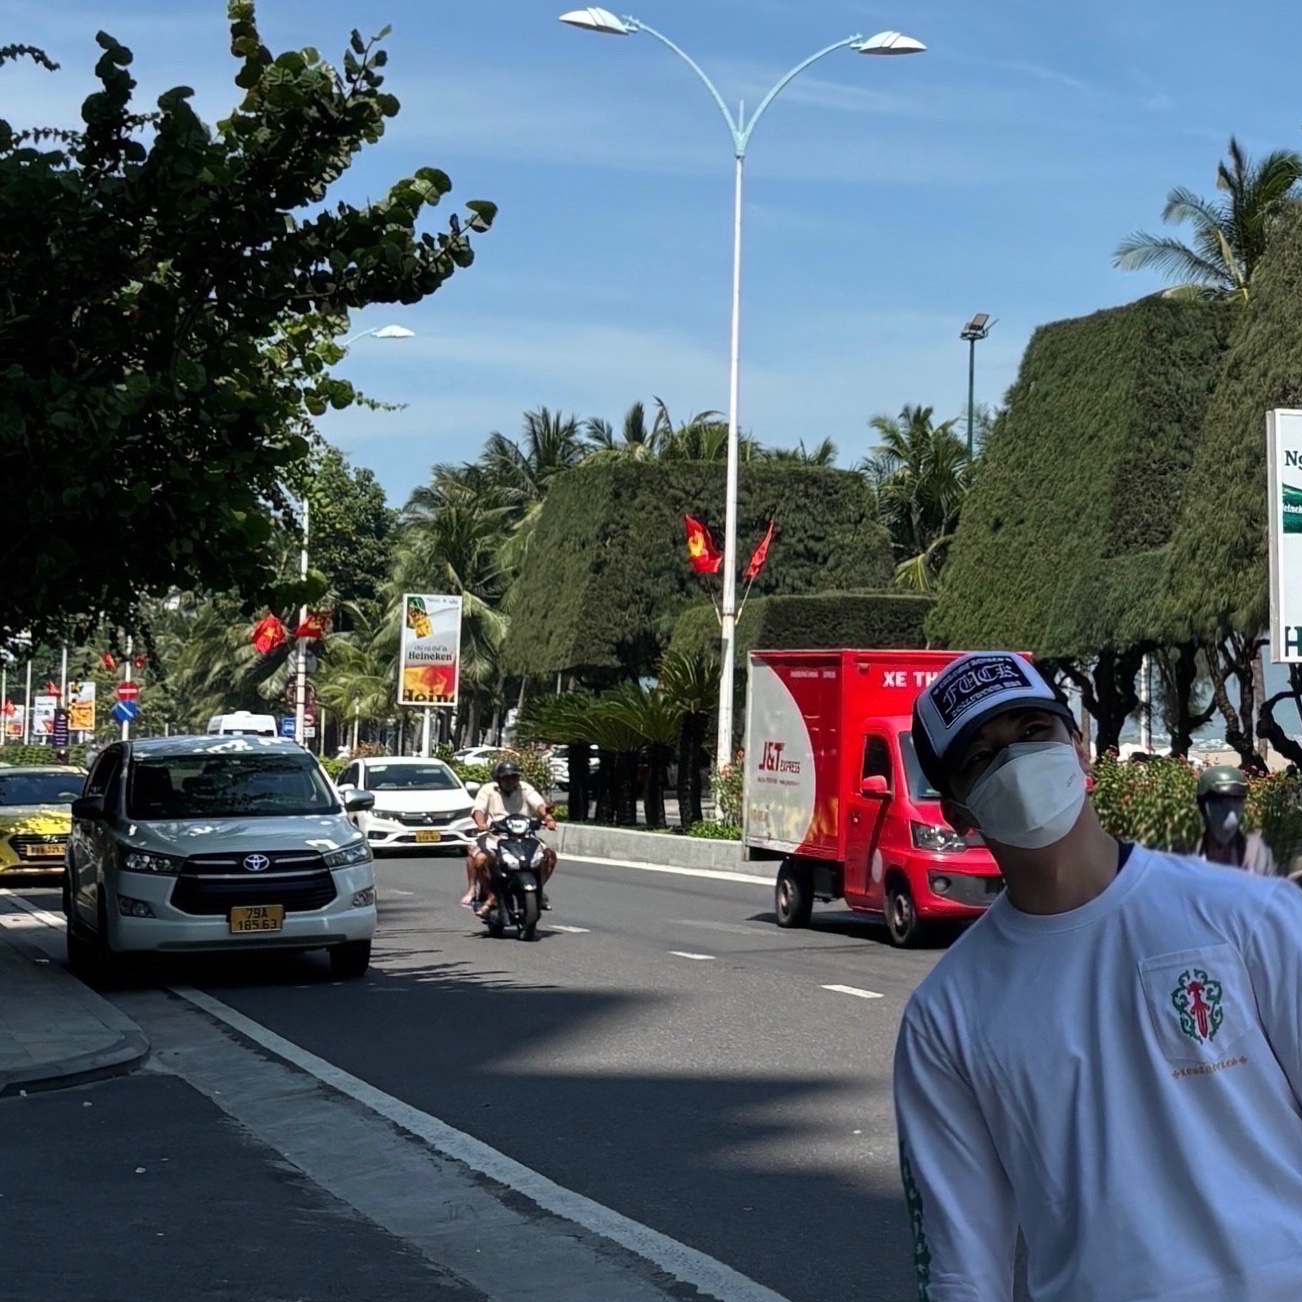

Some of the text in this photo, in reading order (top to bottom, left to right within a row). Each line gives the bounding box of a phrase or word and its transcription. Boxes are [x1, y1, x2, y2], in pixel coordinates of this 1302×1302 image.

[408, 651, 452, 661] Heineken
[883, 671, 907, 688] XE
[943, 663, 1019, 714] FUCK
[758, 741, 785, 771] J&T
[246, 908, 268, 919] 79A
